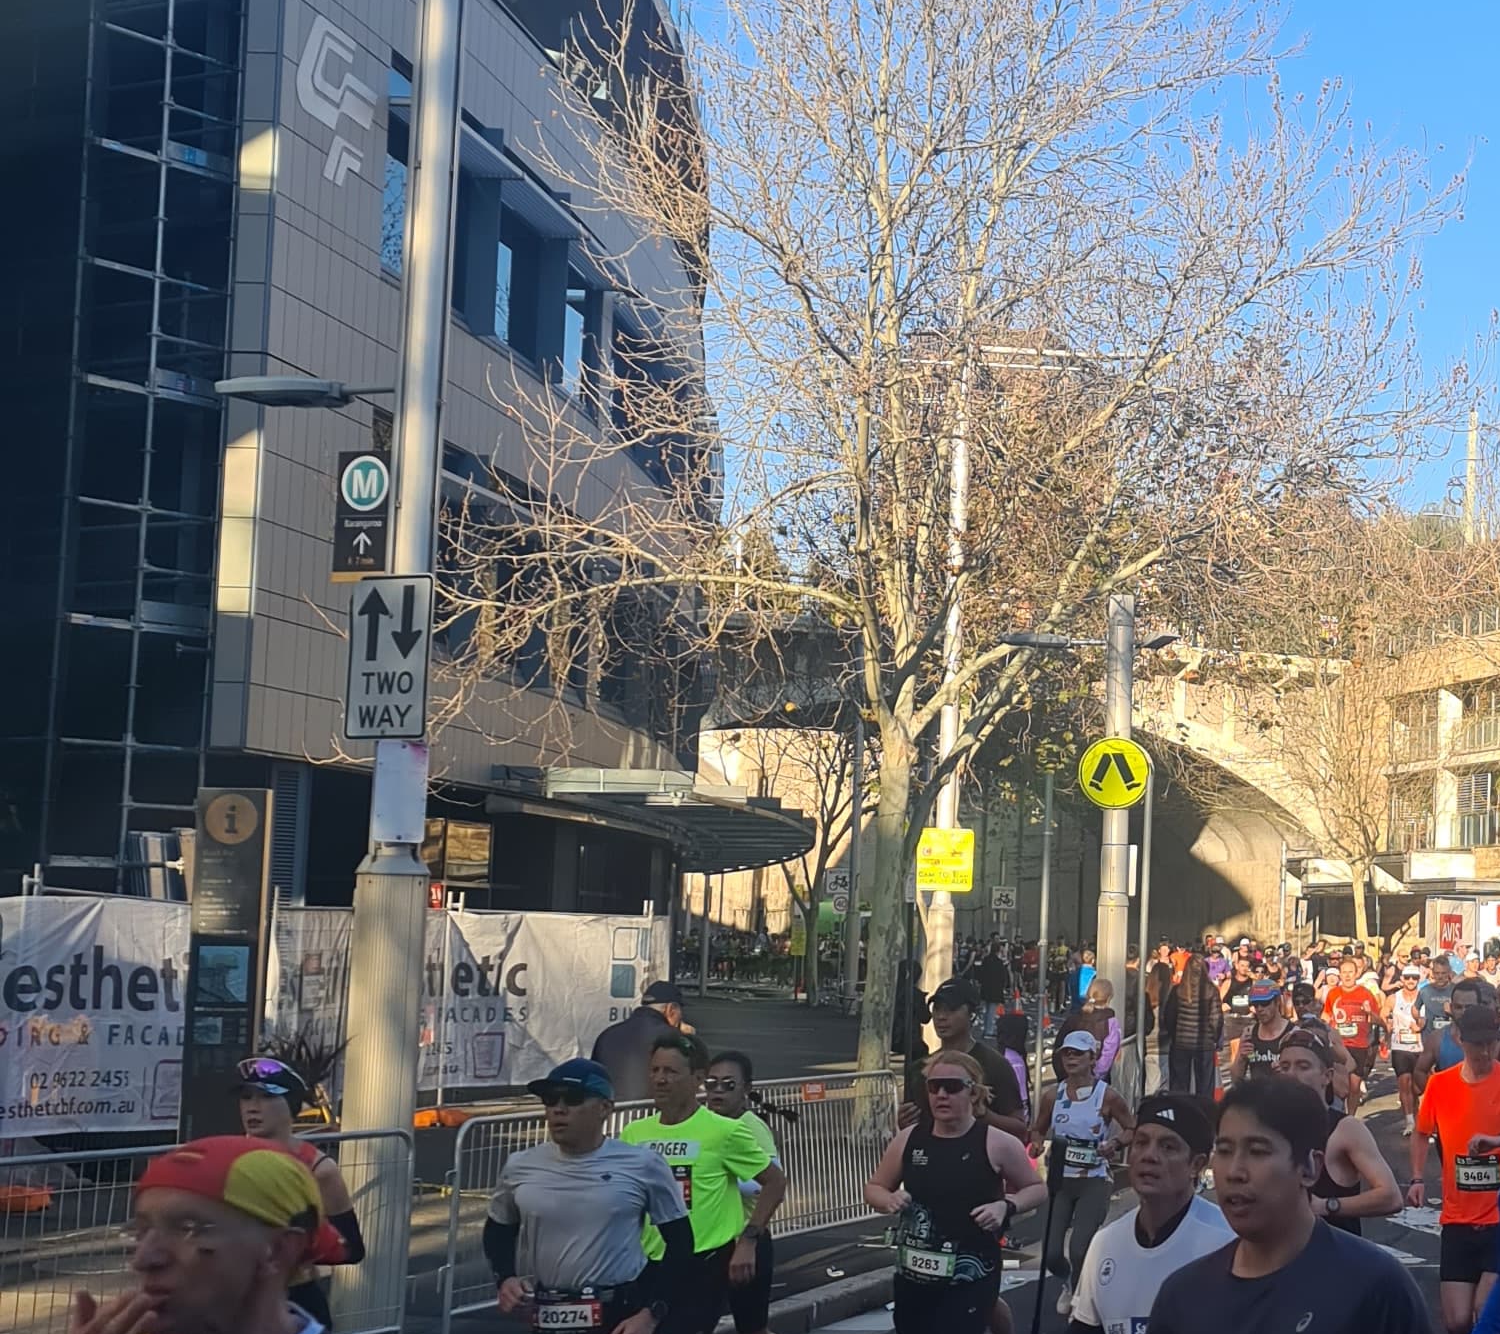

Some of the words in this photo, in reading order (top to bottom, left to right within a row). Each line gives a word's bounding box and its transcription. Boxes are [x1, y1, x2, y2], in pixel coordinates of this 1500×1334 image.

[361, 670, 413, 696] TWO
[358, 704, 413, 729] WAY
[1442, 922, 1462, 941] AVIS
[3, 944, 188, 1013] esthet
[30, 1073, 47, 1089] 02
[541, 1310, 588, 1324] 20274
